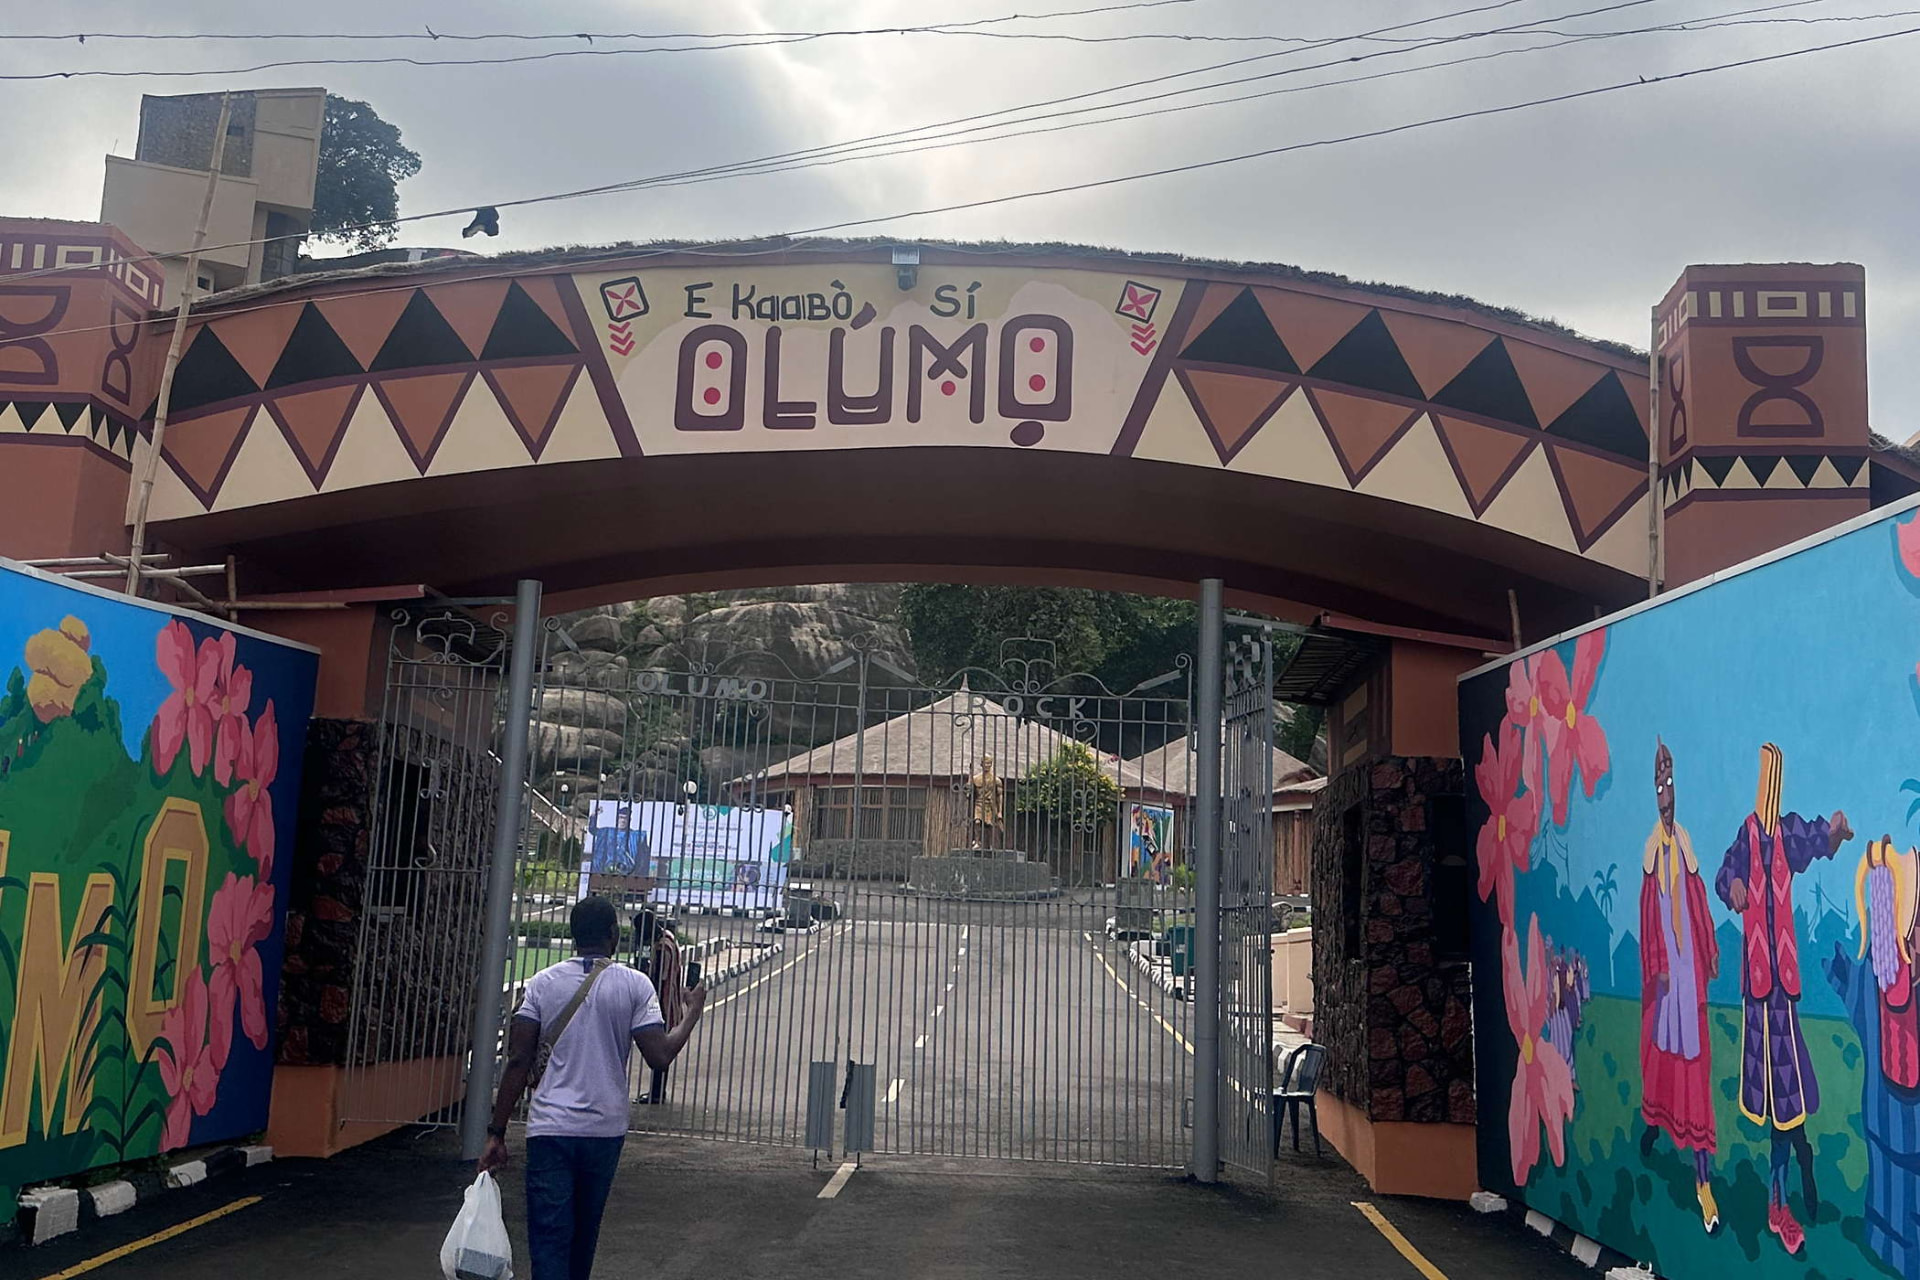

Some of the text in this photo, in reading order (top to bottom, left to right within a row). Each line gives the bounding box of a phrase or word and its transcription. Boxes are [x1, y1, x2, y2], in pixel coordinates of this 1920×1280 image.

[684, 282, 713, 318] E
[636, 671, 1087, 720] OLUMO ROCK
[0, 797, 209, 1149] MO
